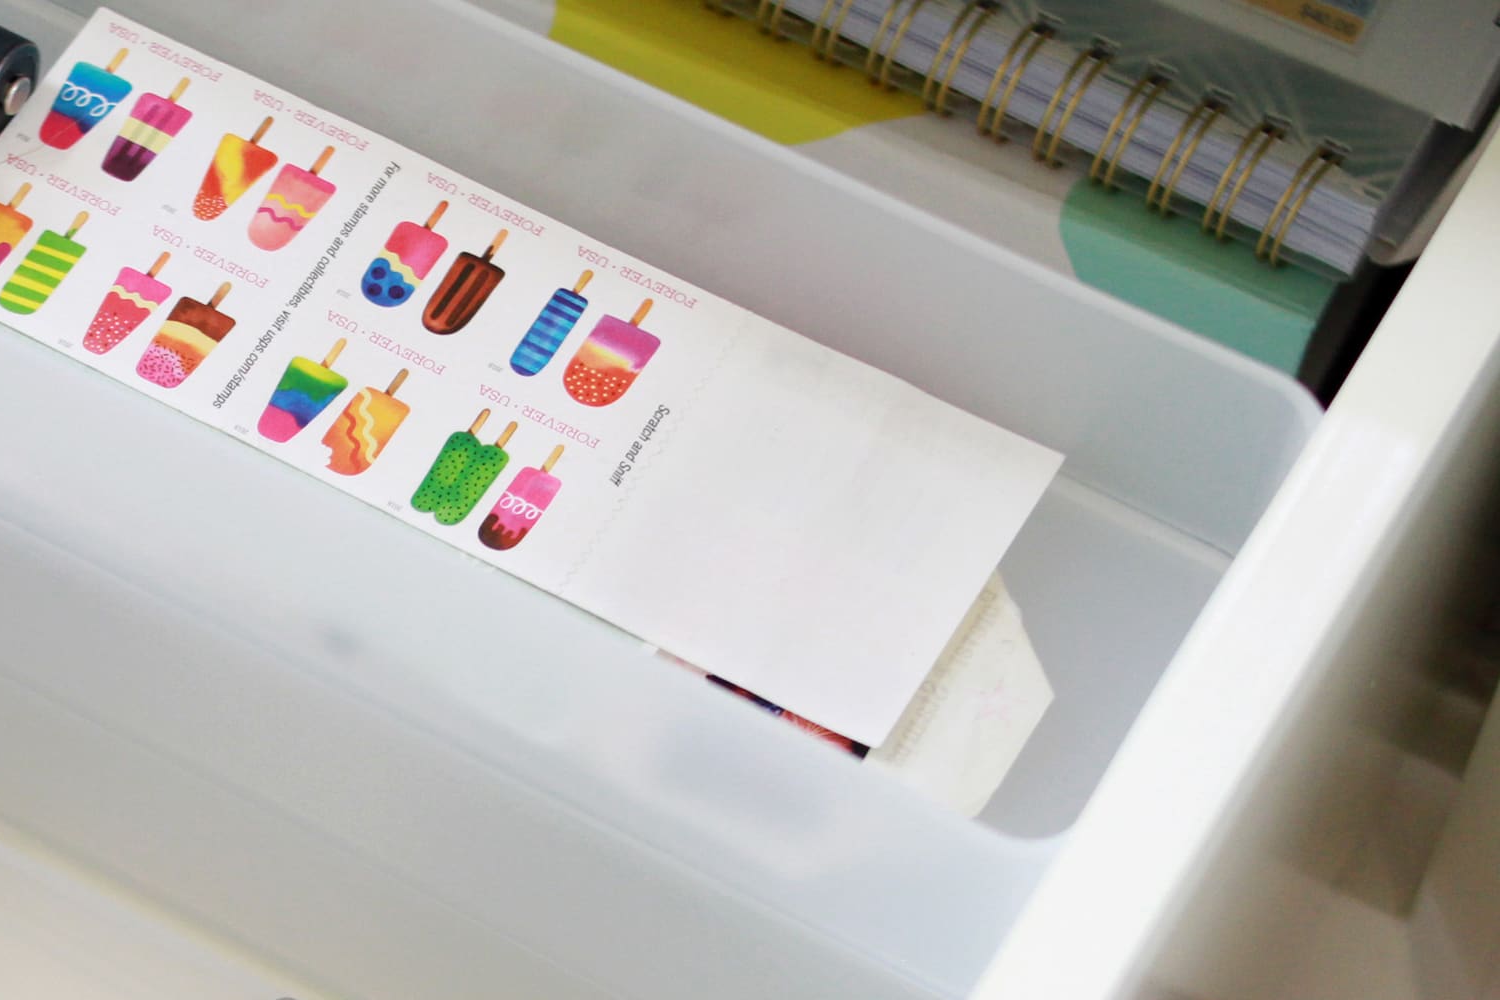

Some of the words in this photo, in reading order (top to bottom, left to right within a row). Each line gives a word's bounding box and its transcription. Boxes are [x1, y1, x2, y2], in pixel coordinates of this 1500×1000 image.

[110, 22, 138, 43] USA
[151, 41, 223, 85] FOREVER
[254, 90, 284, 111] USA
[295, 110, 370, 151] FOREVER
[6, 153, 35, 177] USA
[386, 161, 402, 178] For
[47, 173, 122, 217] FOREVER
[363, 178, 385, 203] more
[428, 172, 458, 195] USA
[338, 203, 367, 238] stamps
[468, 193, 545, 236] FOREVER
[153, 225, 183, 247] USA
[325, 236, 344, 256] and
[194, 246, 269, 288] FOREVER
[578, 246, 610, 268] USA
[287, 257, 331, 310] collectibles,
[620, 266, 698, 308] FOREVER
[272, 311, 289, 330] visit
[328, 310, 359, 333] USA
[369, 332, 447, 375] FOREVER
[213, 330, 274, 407] usps.com/stamps
[480, 384, 511, 407] USA
[522, 406, 601, 448] FOREVER
[641, 405, 670, 442] Scratch
[626, 440, 645, 461] and
[611, 461, 631, 486] Sniff
